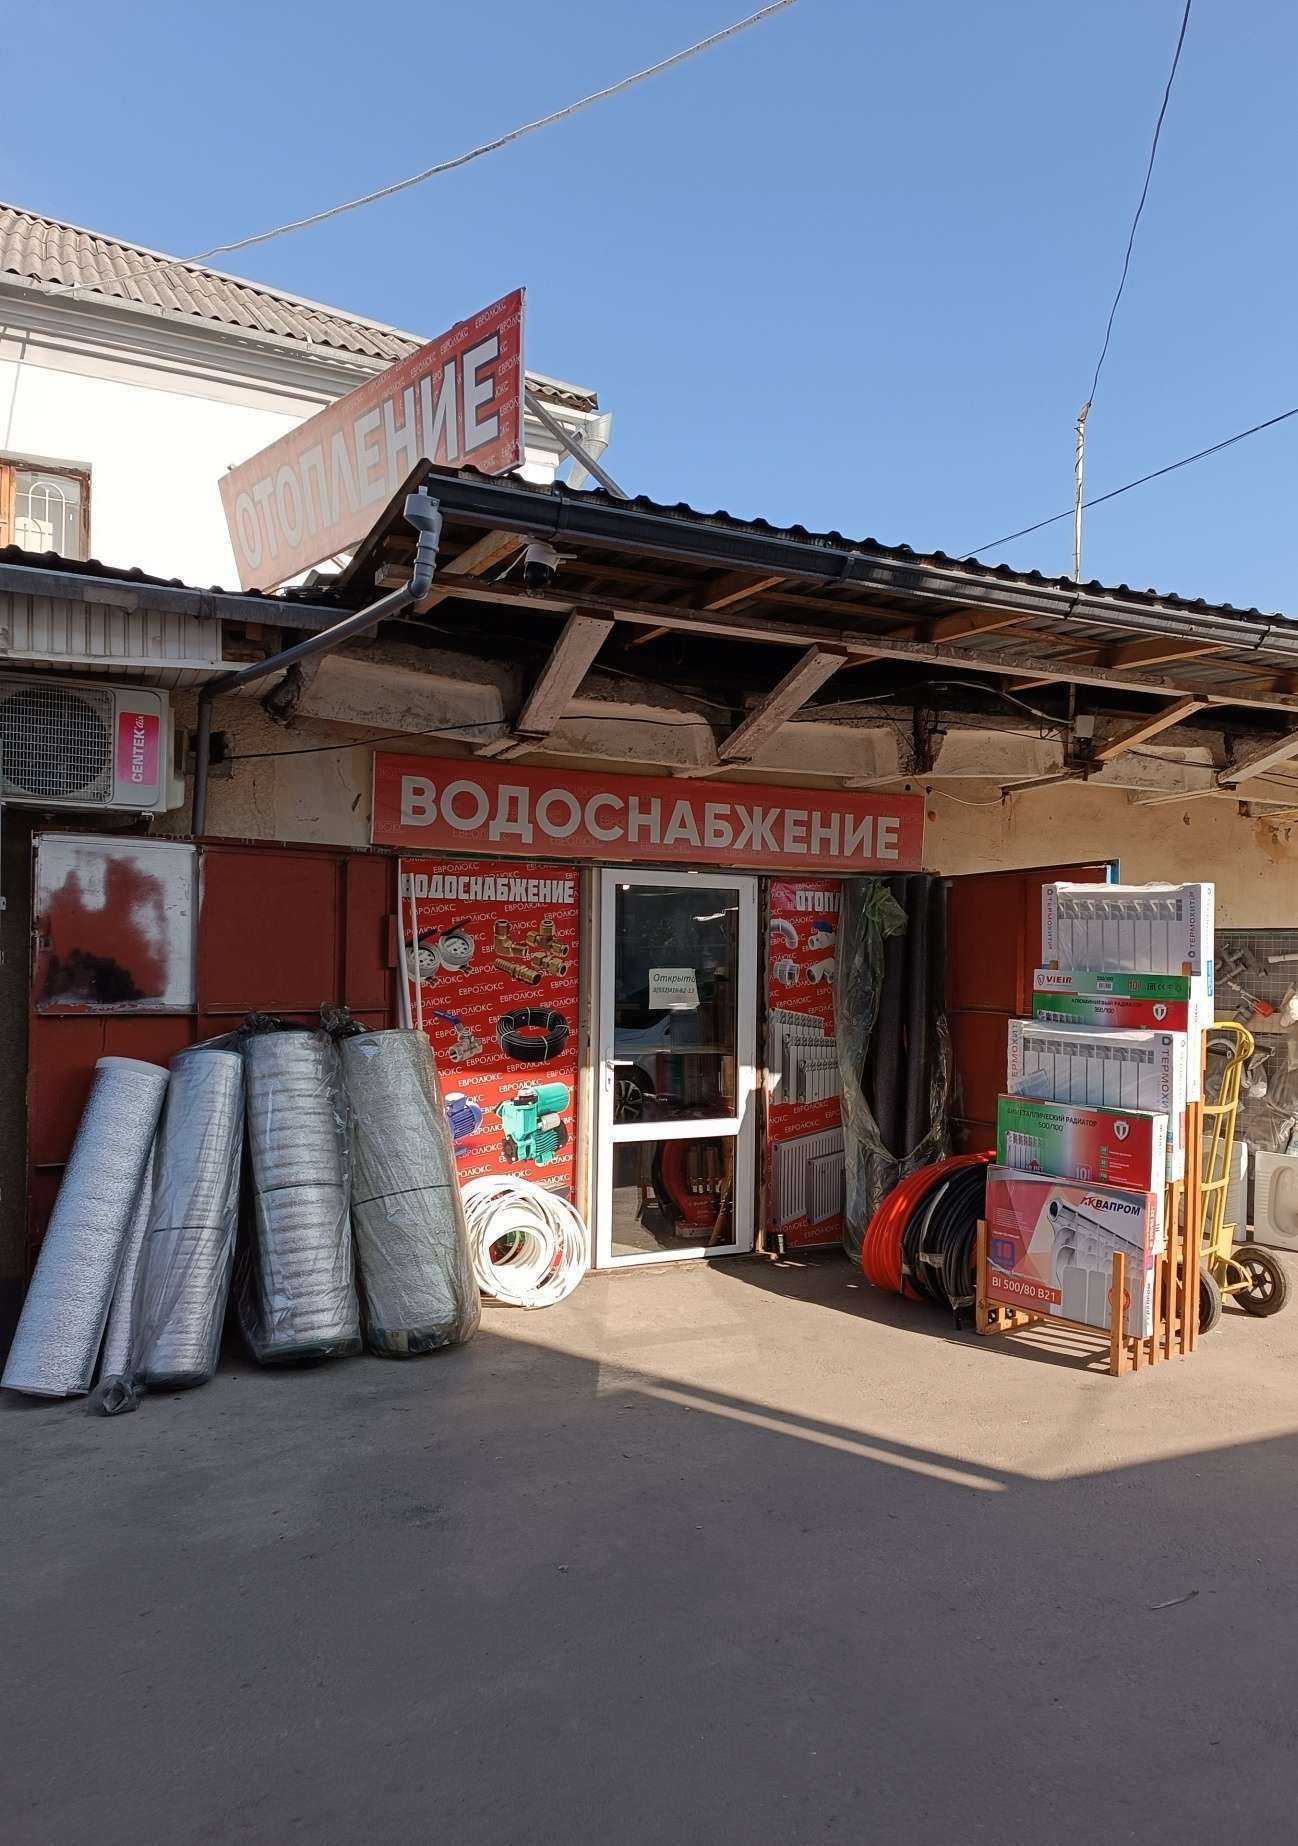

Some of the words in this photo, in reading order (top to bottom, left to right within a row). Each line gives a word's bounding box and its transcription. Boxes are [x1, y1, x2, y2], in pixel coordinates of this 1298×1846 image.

[235, 333, 501, 570] ОТОПЛЕНИЕ
[132, 729, 145, 783] CENTEK
[400, 775, 899, 860] ВОДОСНАБЖЕНИЕ
[401, 872, 575, 904] ВОДОСНАБЖЕНИЕ
[1011, 1024, 1019, 1078] ЕРМОХИТ
[458, 1073, 503, 1088] ЕВРОЛЮКС
[1160, 1050, 1170, 1113] ТЕРМОХИ
[456, 1164, 492, 1178] РОЛЮКС
[1080, 1196, 1141, 1216] АКВАПРОМ
[1003, 1279, 1036, 1297] 500/80
[1038, 1288, 1055, 1302] B21
